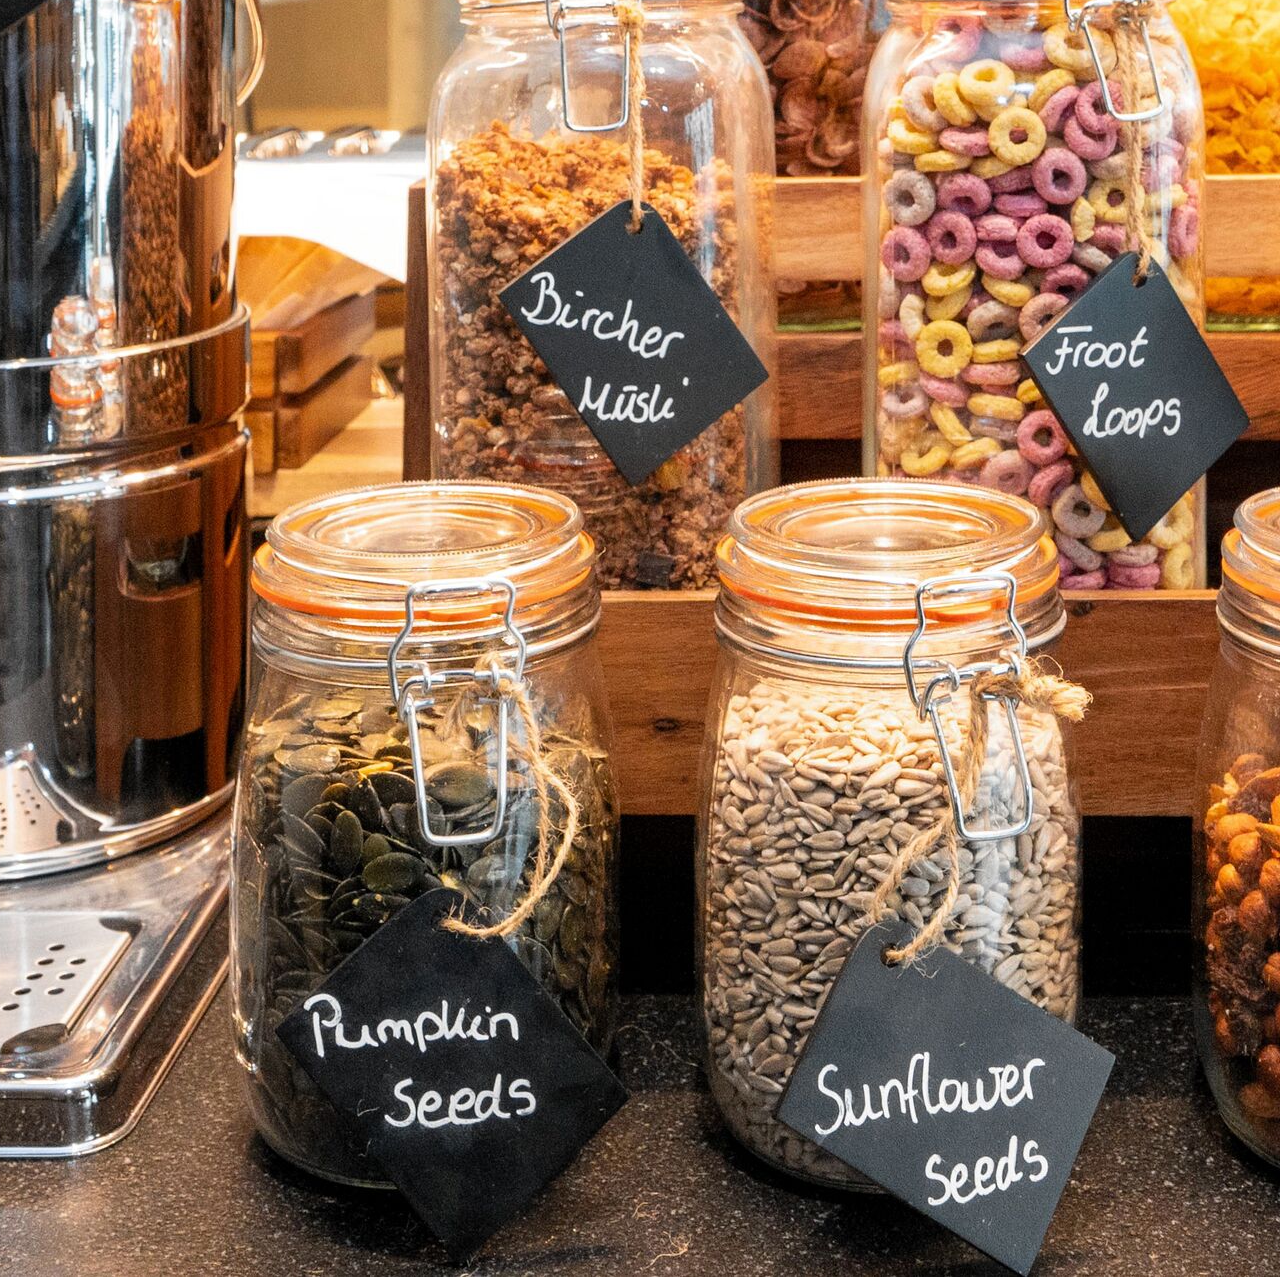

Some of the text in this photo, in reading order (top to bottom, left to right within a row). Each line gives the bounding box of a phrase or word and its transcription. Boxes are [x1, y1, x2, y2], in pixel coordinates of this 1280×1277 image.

[521, 272, 685, 358] Bircher
[1045, 325, 1149, 375] Froot
[1082, 382, 1181, 438] Loops
[303, 993, 519, 1057] Pumpkin
[384, 1074, 536, 1128] Seeds
[815, 1052, 1046, 1135] Sunflower
[925, 1135, 1049, 1206] Seeds
